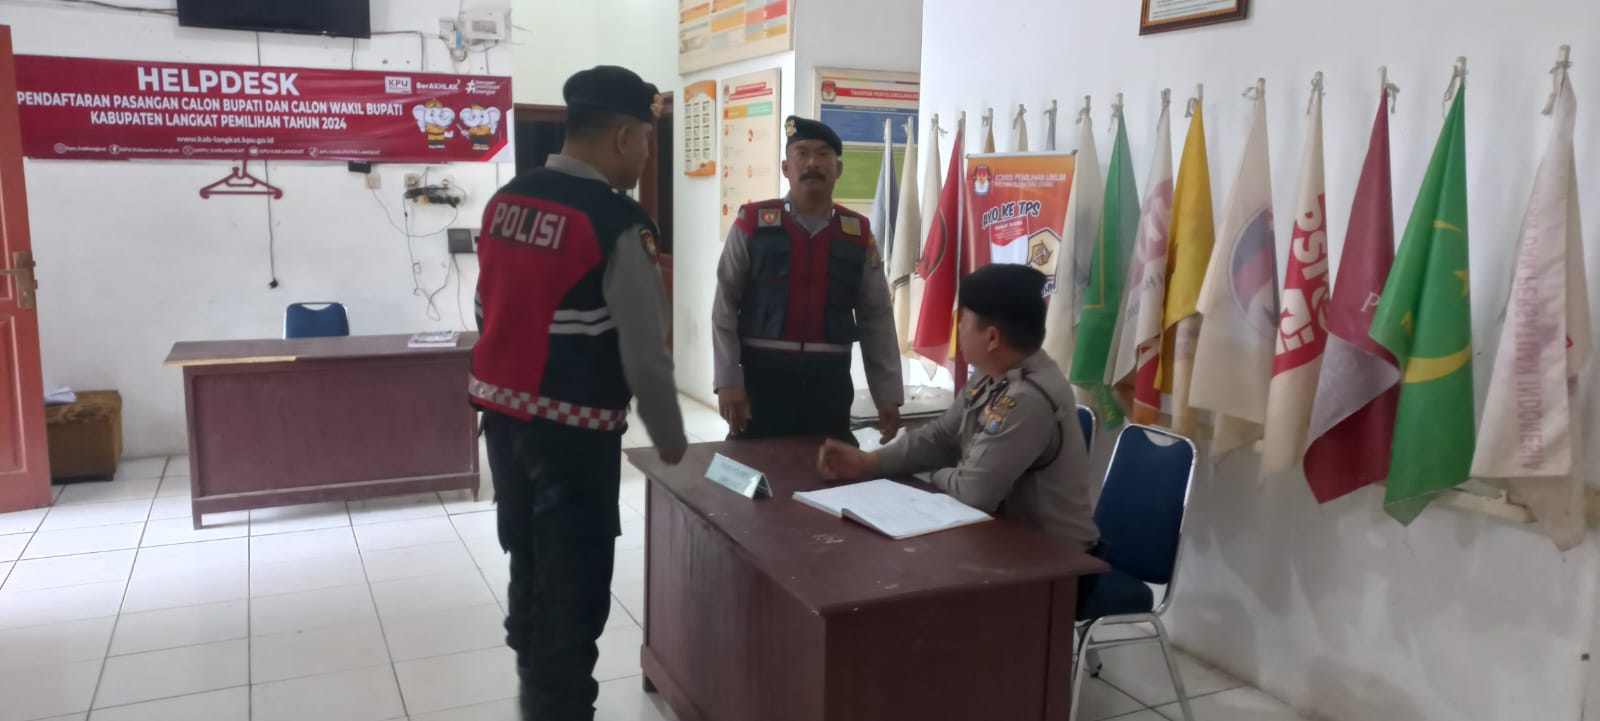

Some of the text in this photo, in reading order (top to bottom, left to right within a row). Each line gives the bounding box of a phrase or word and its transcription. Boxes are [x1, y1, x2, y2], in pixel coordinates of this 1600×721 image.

[137, 66, 300, 96] HELPDESK
[388, 79, 408, 88] KPU
[16, 90, 403, 116] PENDAFTARAN PASANGAN CALON BUPATI DAN CALON WAKIL BUPATI
[91, 110, 347, 130] KABUPATEN LANGKAT PEMILIHAN TAHUN 2024
[489, 202, 567, 250] POLISI
[983, 200, 1041, 227] AYO KE TPS
